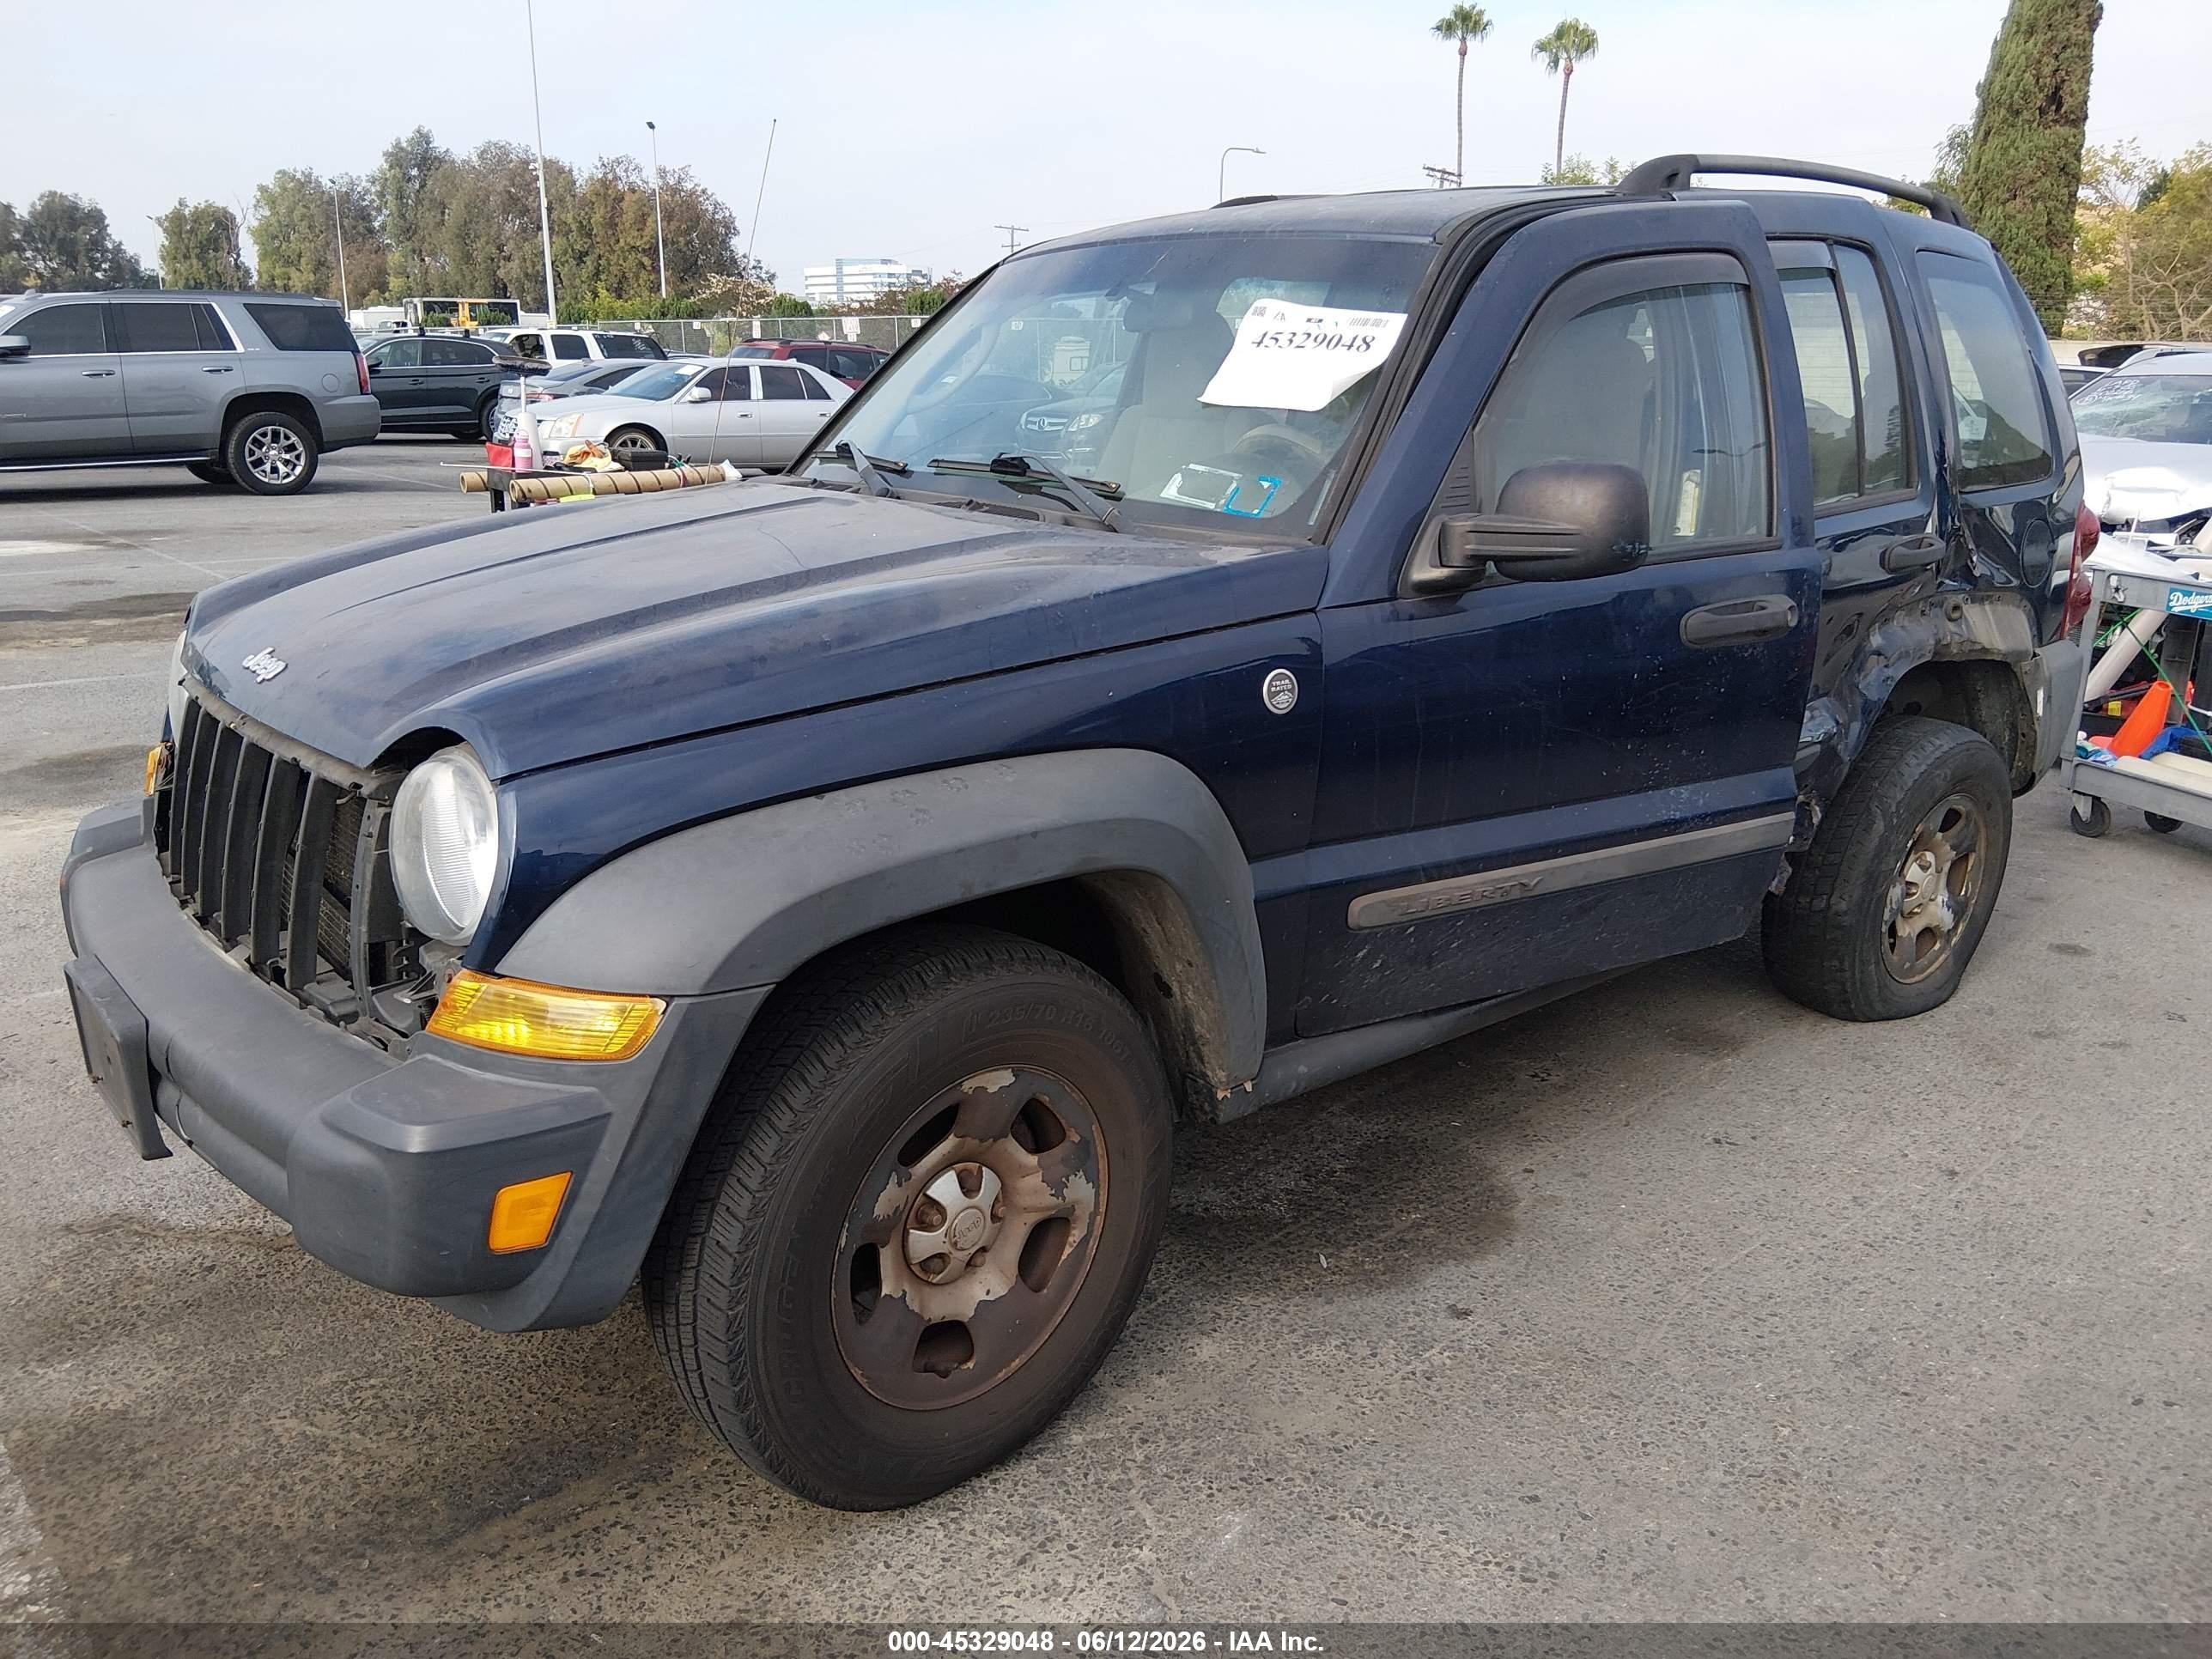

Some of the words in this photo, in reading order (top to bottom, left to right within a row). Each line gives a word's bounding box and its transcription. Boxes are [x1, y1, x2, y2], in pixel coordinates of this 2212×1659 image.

[1251, 331, 1376, 353] 45329048
[242, 647, 288, 684] Jeep
[1401, 876, 1544, 915] LIBERTY
[987, 1003, 1057, 1029] 235/70
